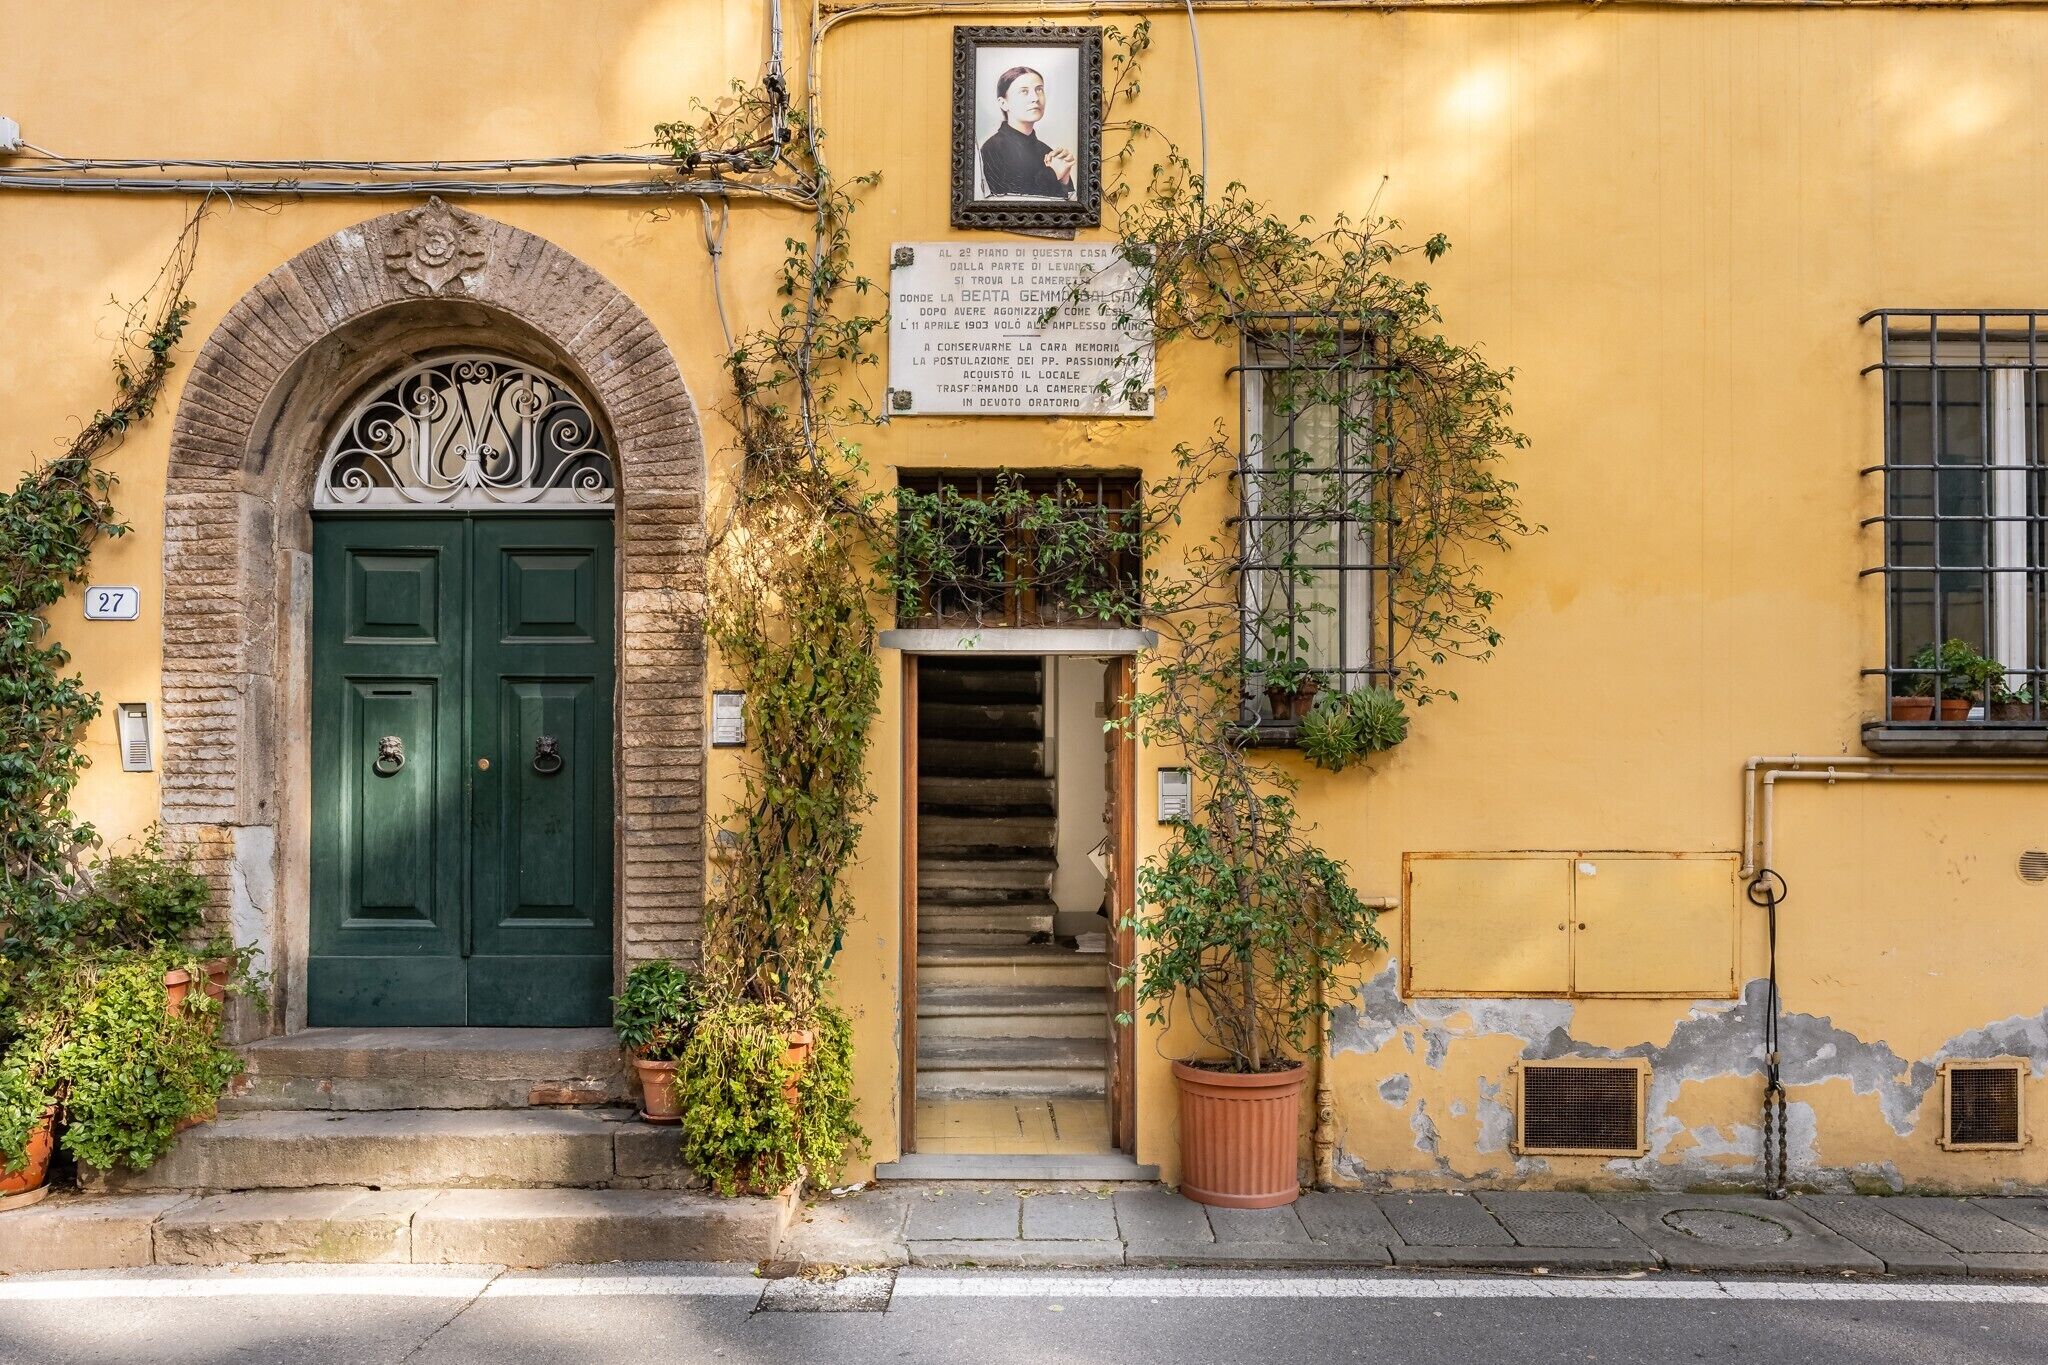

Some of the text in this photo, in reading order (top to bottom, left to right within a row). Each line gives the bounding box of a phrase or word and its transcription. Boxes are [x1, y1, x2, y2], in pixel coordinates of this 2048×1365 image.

[939, 249, 952, 257] AL
[978, 249, 1009, 257] PIANO
[1016, 249, 1025, 257] DI
[1033, 249, 1073, 259] QUESTA
[1080, 249, 1107, 257] CASA
[950, 262, 984, 271] DALLA
[991, 262, 1024, 271] PARTE
[1032, 262, 1041, 271] DI
[954, 276, 964, 285] SI
[971, 276, 1003, 285] TROVA
[1011, 276, 1024, 285] LA
[900, 294, 933, 302] DONDE
[941, 294, 954, 302] LA
[961, 290, 1010, 301] BEATA
[920, 307, 947, 316] DOPO
[954, 307, 986, 316] AVERE
[1064, 307, 1091, 316] COME
[924, 321, 960, 330] APRILE
[965, 321, 989, 330] 1903
[1052, 321, 1106, 331] AMPLESSO
[925, 343, 1120, 352] A CONSERVARNE LA CARA MEMORIA
[913, 357, 926, 365] LA
[933, 357, 1010, 365] POSTULAZIONE
[1017, 357, 1034, 365] DEI
[1041, 357, 1059, 366] PP.
[1021, 371, 1031, 379] IL
[1039, 371, 1080, 379] LOCALE
[1026, 384, 1039, 393] LA
[1046, 384, 1103, 394] CAMERET
[963, 398, 1080, 407] IN DEVOTO ORATORIO
[99, 592, 124, 612] 27
